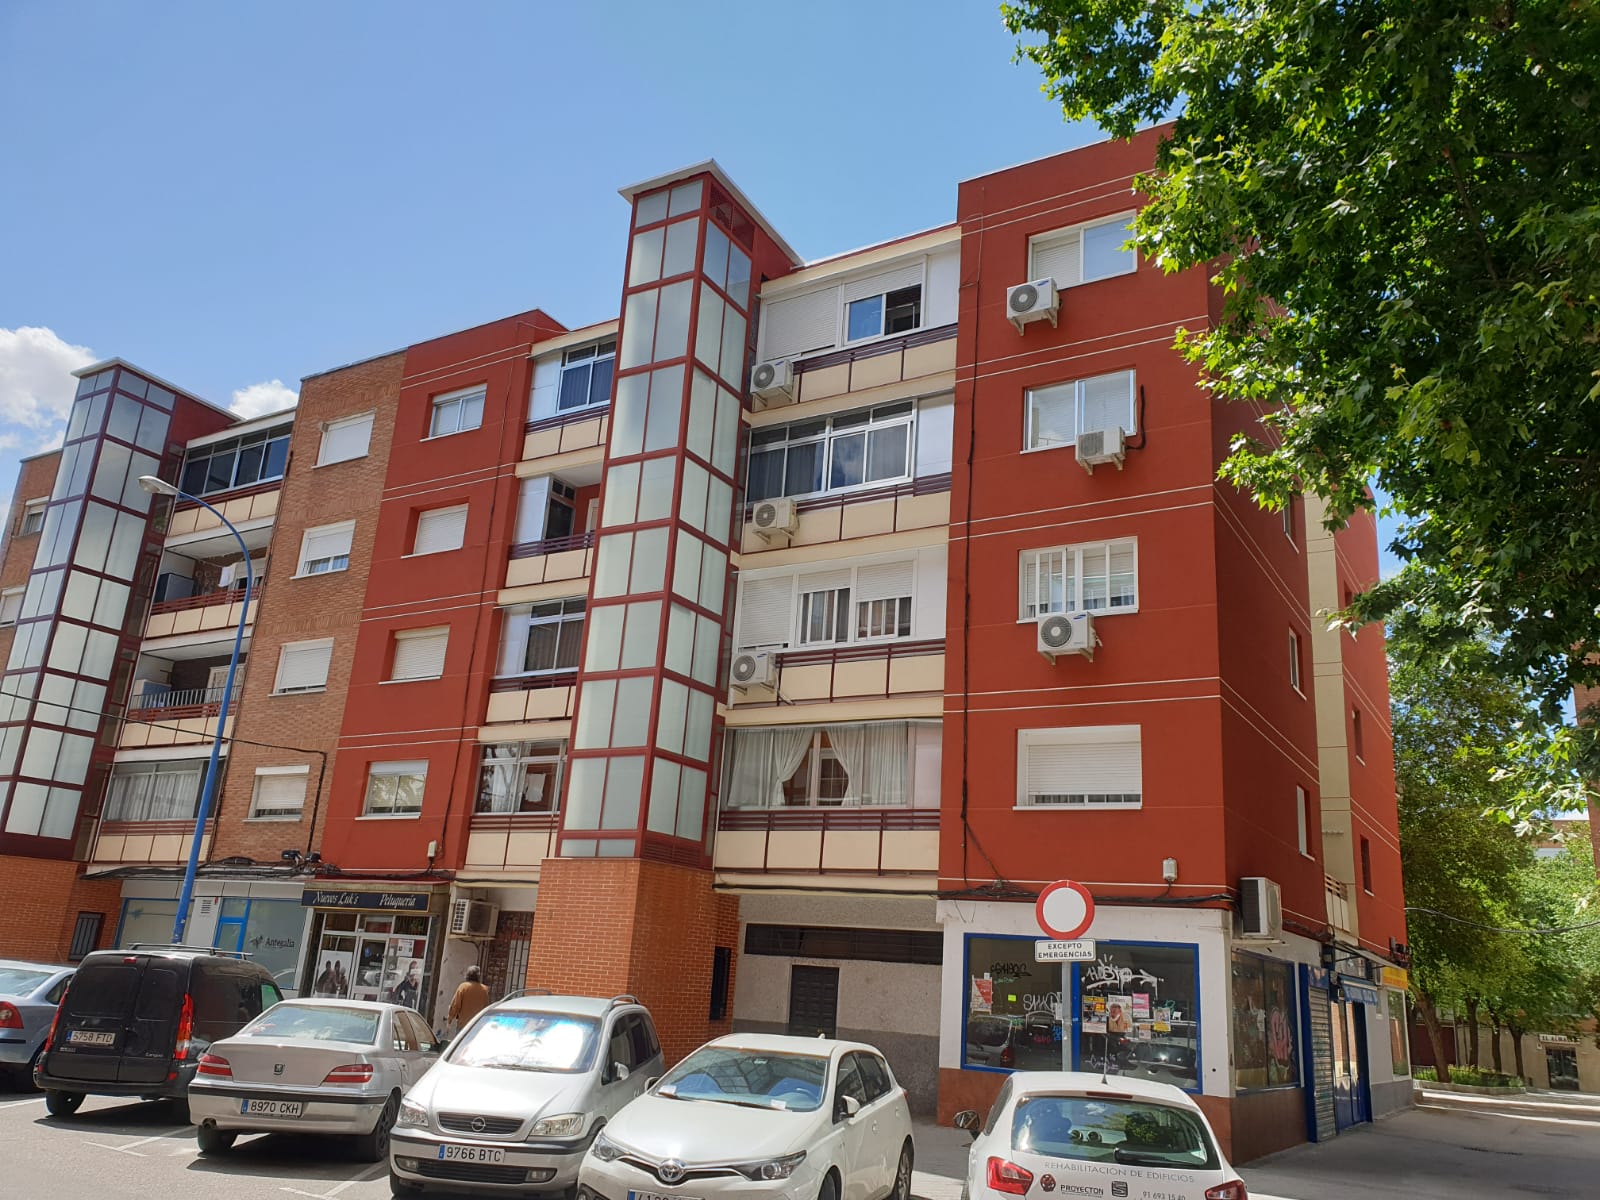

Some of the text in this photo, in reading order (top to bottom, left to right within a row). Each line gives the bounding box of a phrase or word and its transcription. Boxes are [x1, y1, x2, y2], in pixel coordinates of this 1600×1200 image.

[1047, 942, 1082, 950] EXCEPTO
[1038, 950, 1093, 959] EMERGENCIAS
[250, 1101, 299, 1115] 8970 CKH
[446, 1146, 501, 1162] 9766 BTC
[1130, 1169, 1144, 1178] DE
[1146, 1171, 1195, 1184] EDIFICIOS
[1060, 1184, 1104, 1196] PROYECTON
